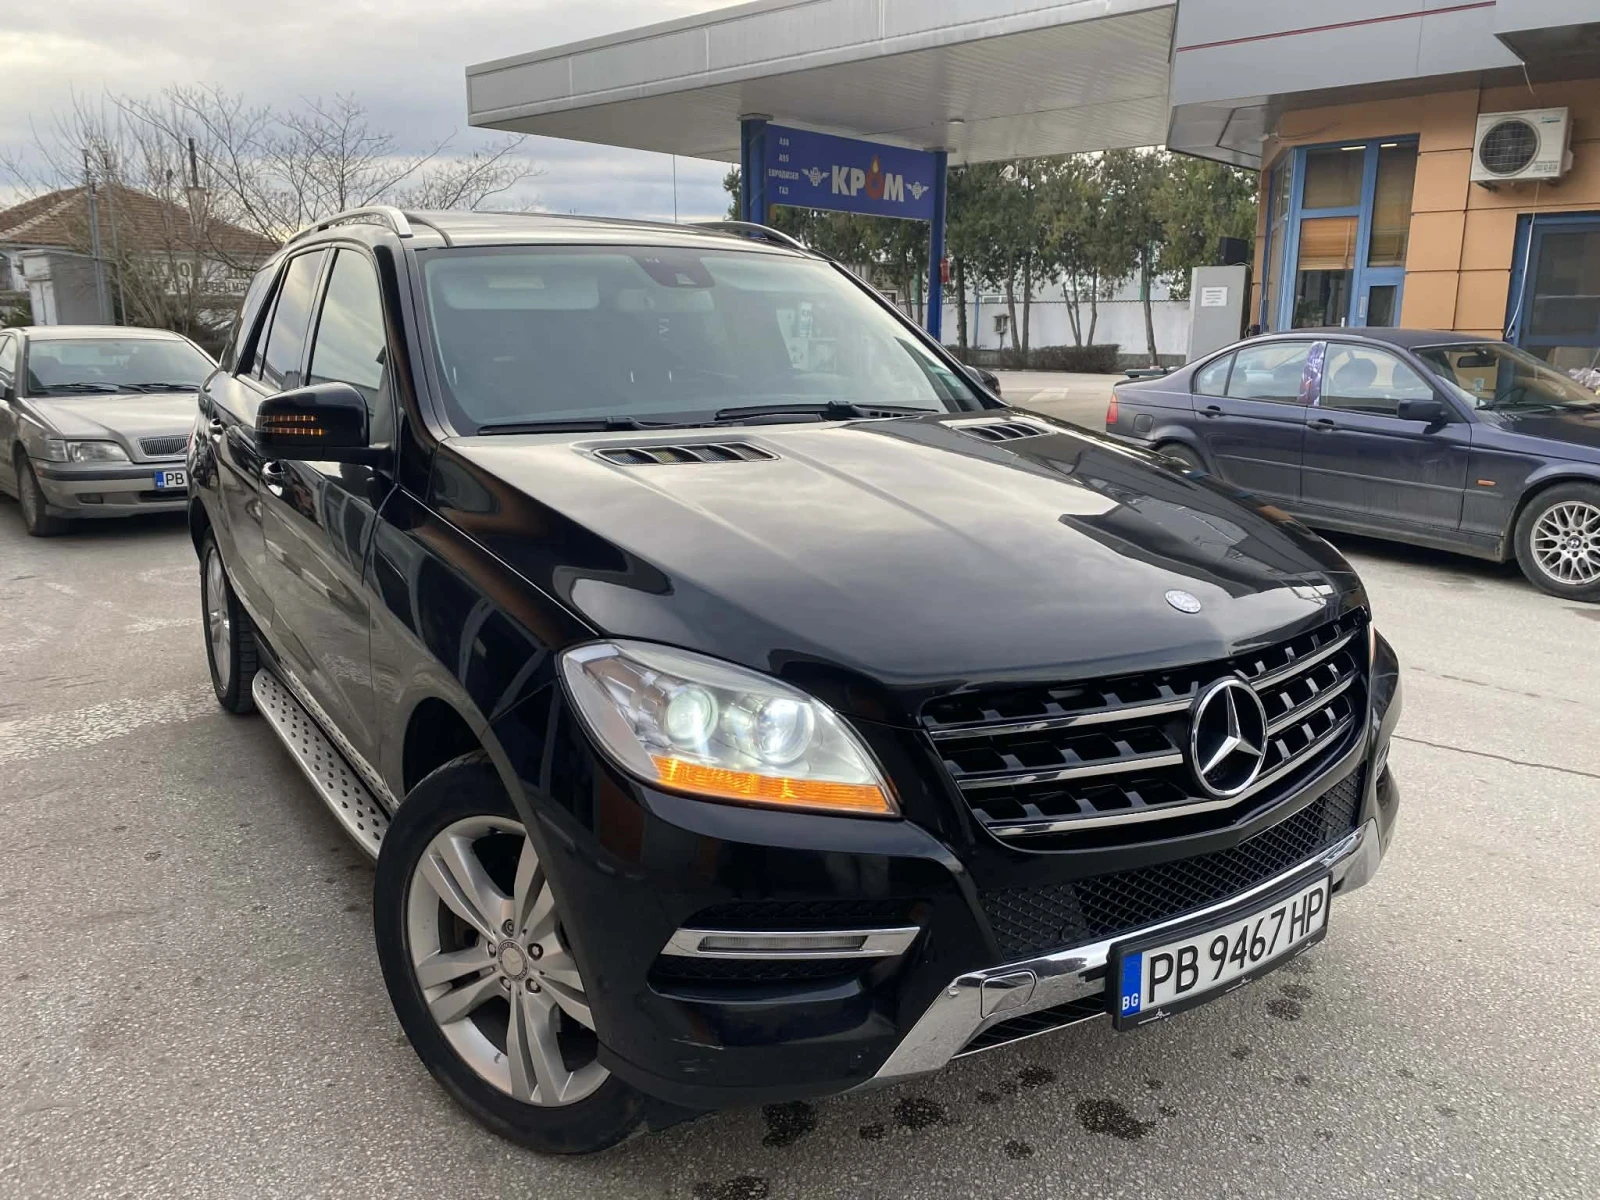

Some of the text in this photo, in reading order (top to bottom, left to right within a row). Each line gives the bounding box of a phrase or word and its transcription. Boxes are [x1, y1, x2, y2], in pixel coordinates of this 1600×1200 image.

[165, 472, 184, 485] PB
[1148, 887, 1324, 1004] PB 9467 HP
[1122, 993, 1139, 1011] BG
